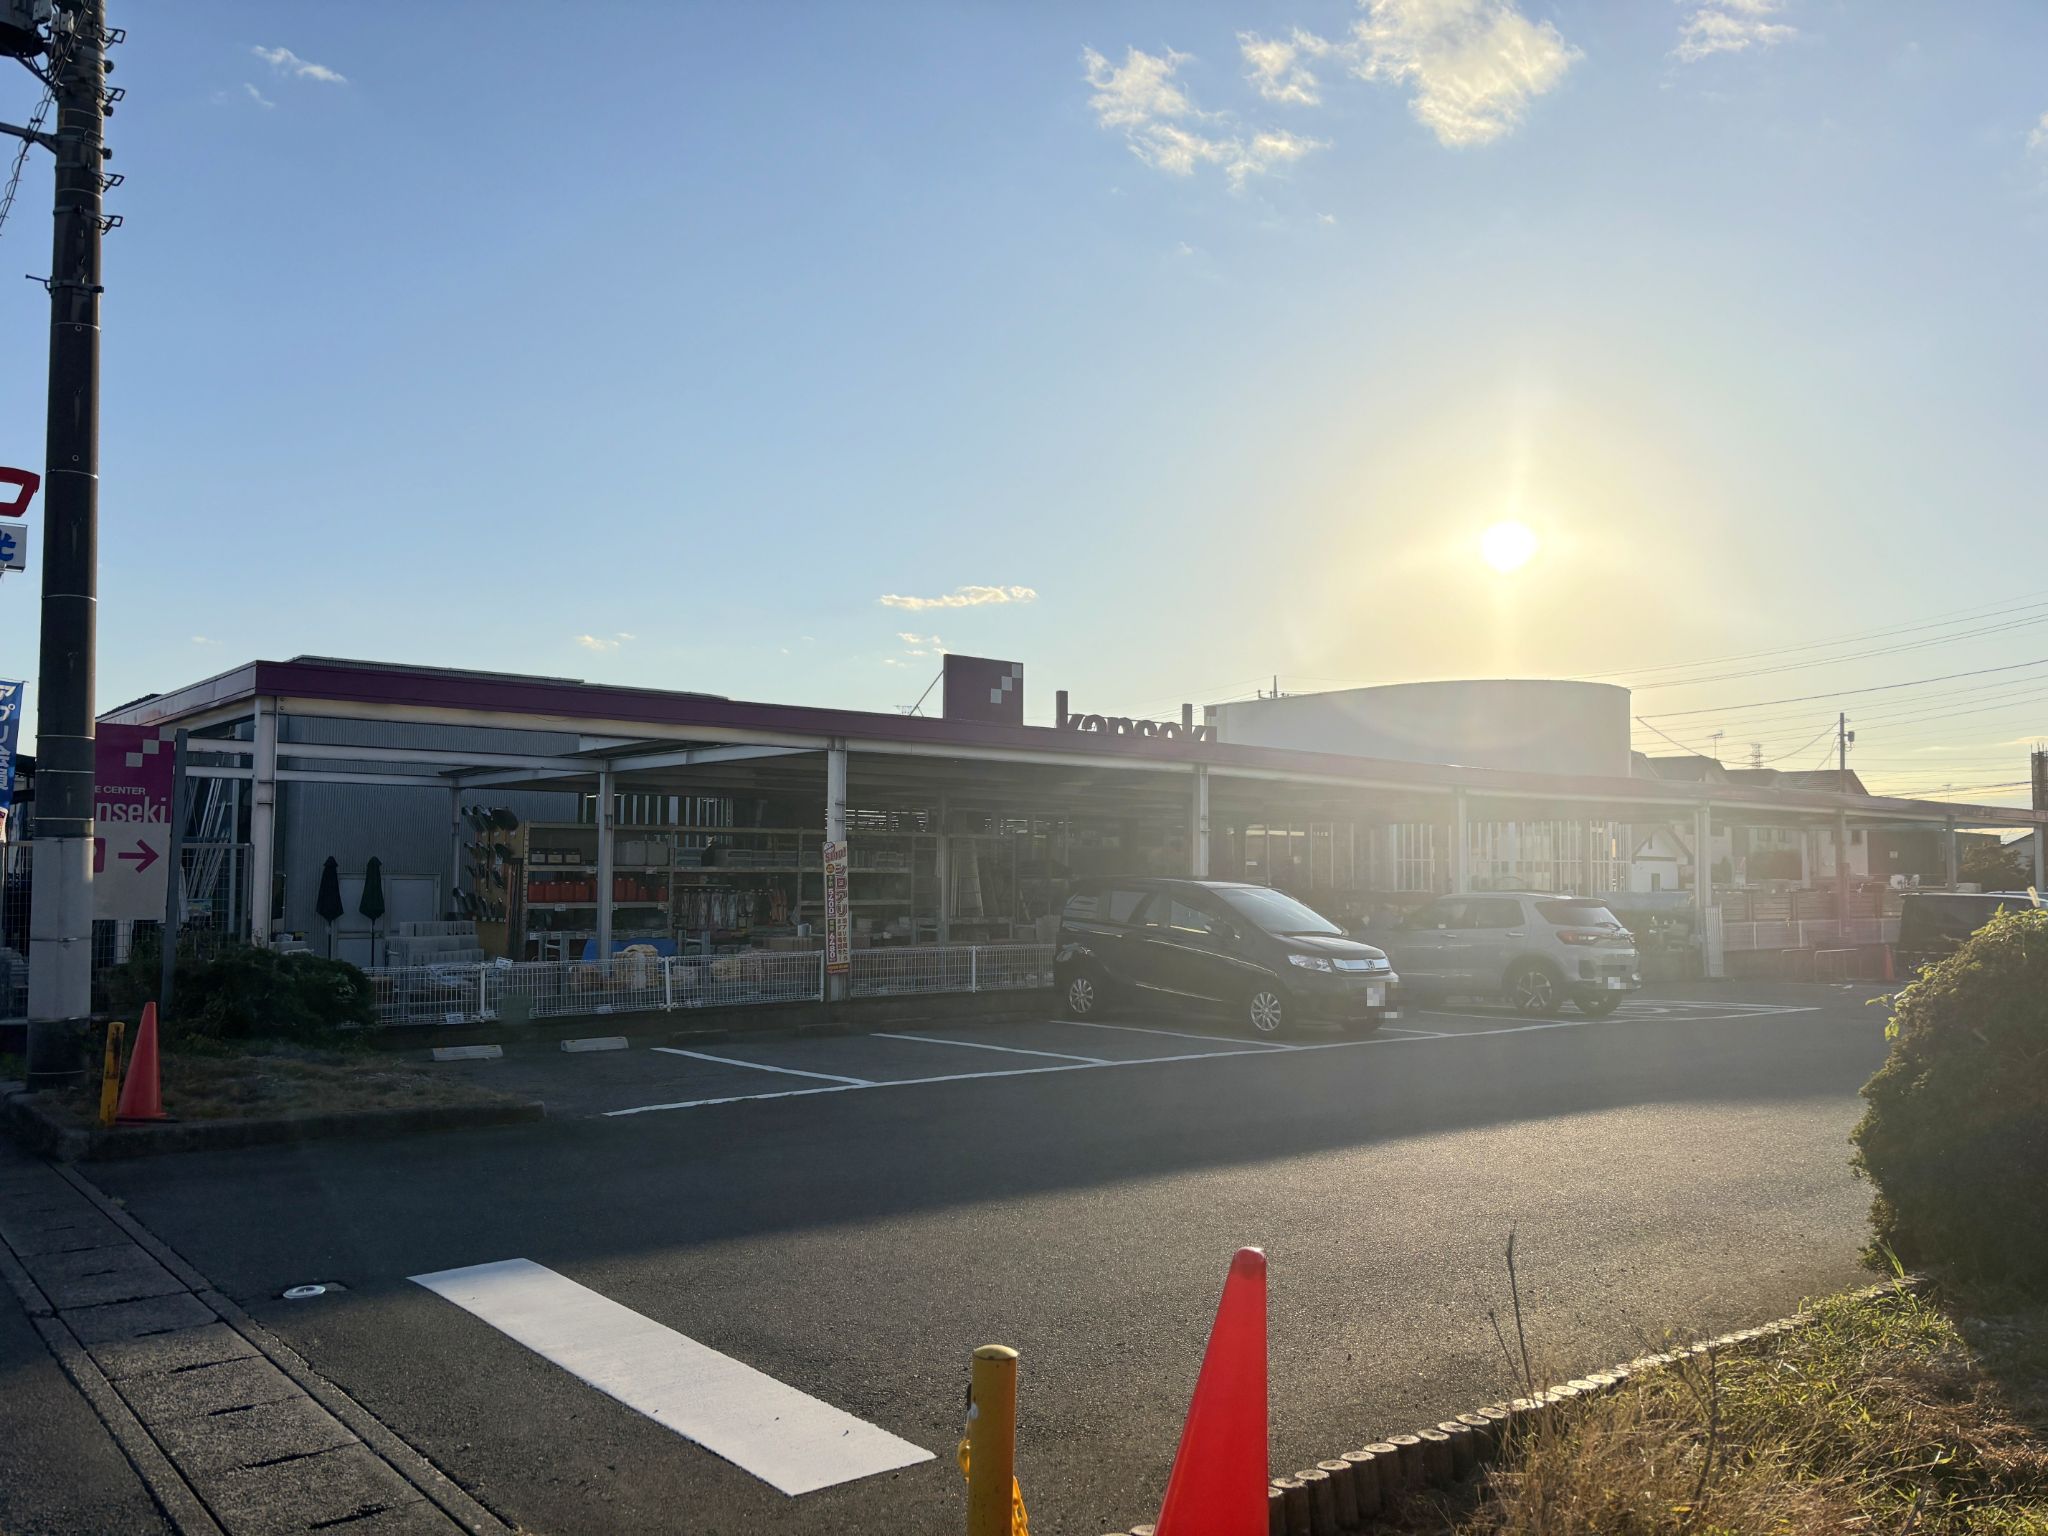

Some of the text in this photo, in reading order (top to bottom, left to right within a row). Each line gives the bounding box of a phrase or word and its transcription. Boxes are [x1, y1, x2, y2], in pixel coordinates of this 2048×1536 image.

[103, 786, 146, 795] CENTER
[96, 796, 167, 823] nseki
[835, 864, 848, 918] シロアリ
